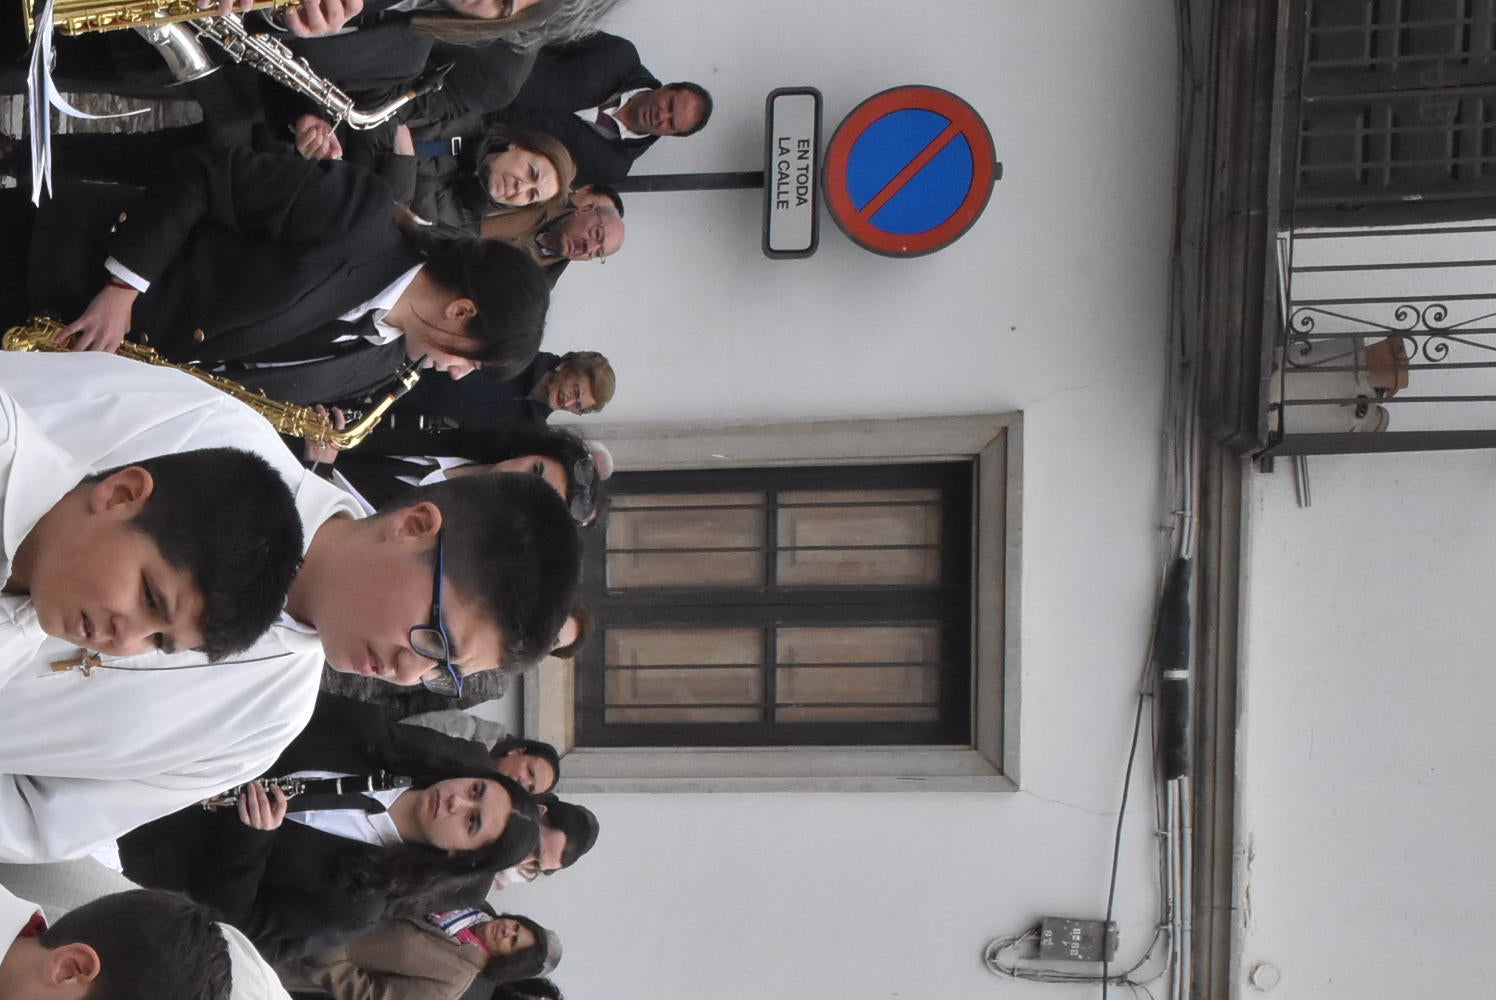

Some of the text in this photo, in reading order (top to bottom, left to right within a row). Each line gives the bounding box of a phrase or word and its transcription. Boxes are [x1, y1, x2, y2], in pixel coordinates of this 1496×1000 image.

[776, 137, 791, 209] LA CALLE
[796, 139, 810, 207] EN TODA
